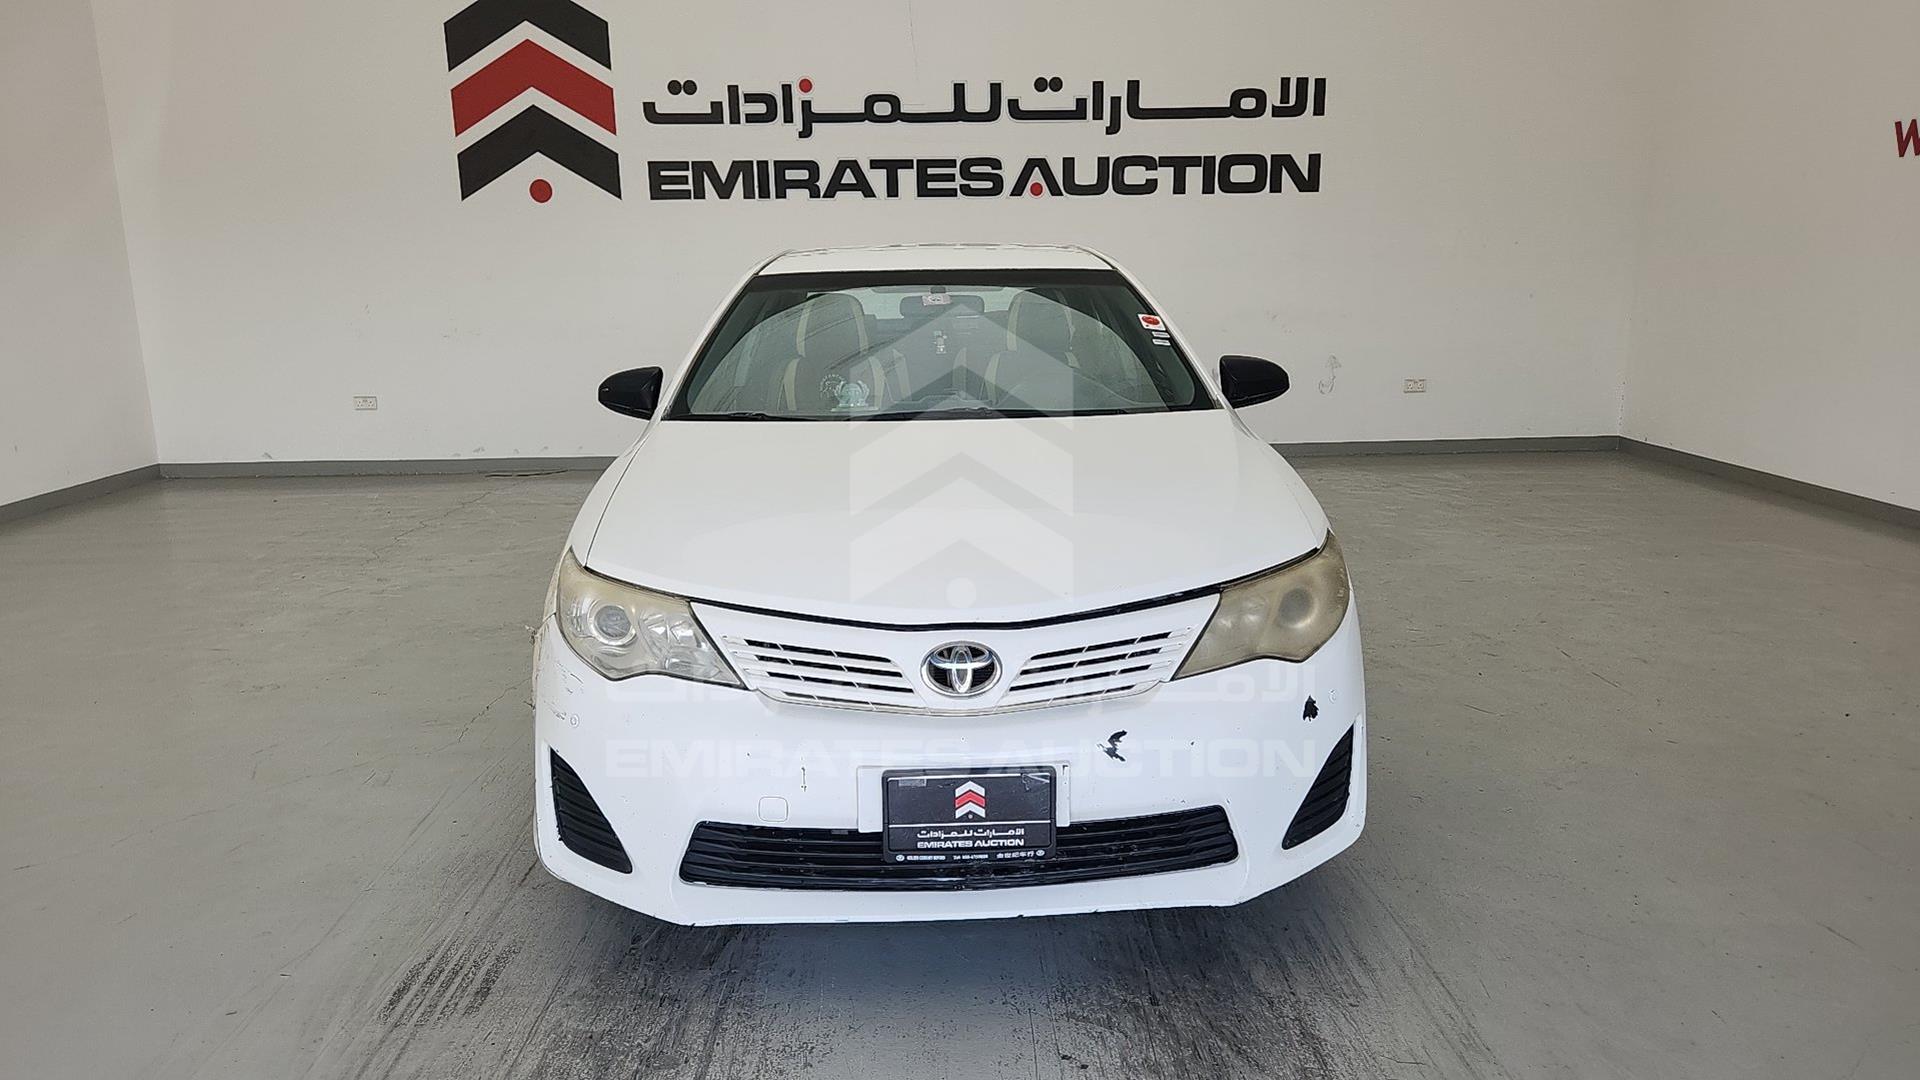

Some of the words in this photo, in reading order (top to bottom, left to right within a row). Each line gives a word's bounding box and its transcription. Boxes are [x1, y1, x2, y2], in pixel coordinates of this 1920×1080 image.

[642, 78, 1002, 138] للمزادات
[1007, 76, 1327, 136] الامارات
[647, 156, 1003, 201] EMIRATES
[1009, 152, 1322, 197] AUCTION
[917, 840, 973, 849] EMIRATES
[974, 838, 1025, 847] AUCTION
